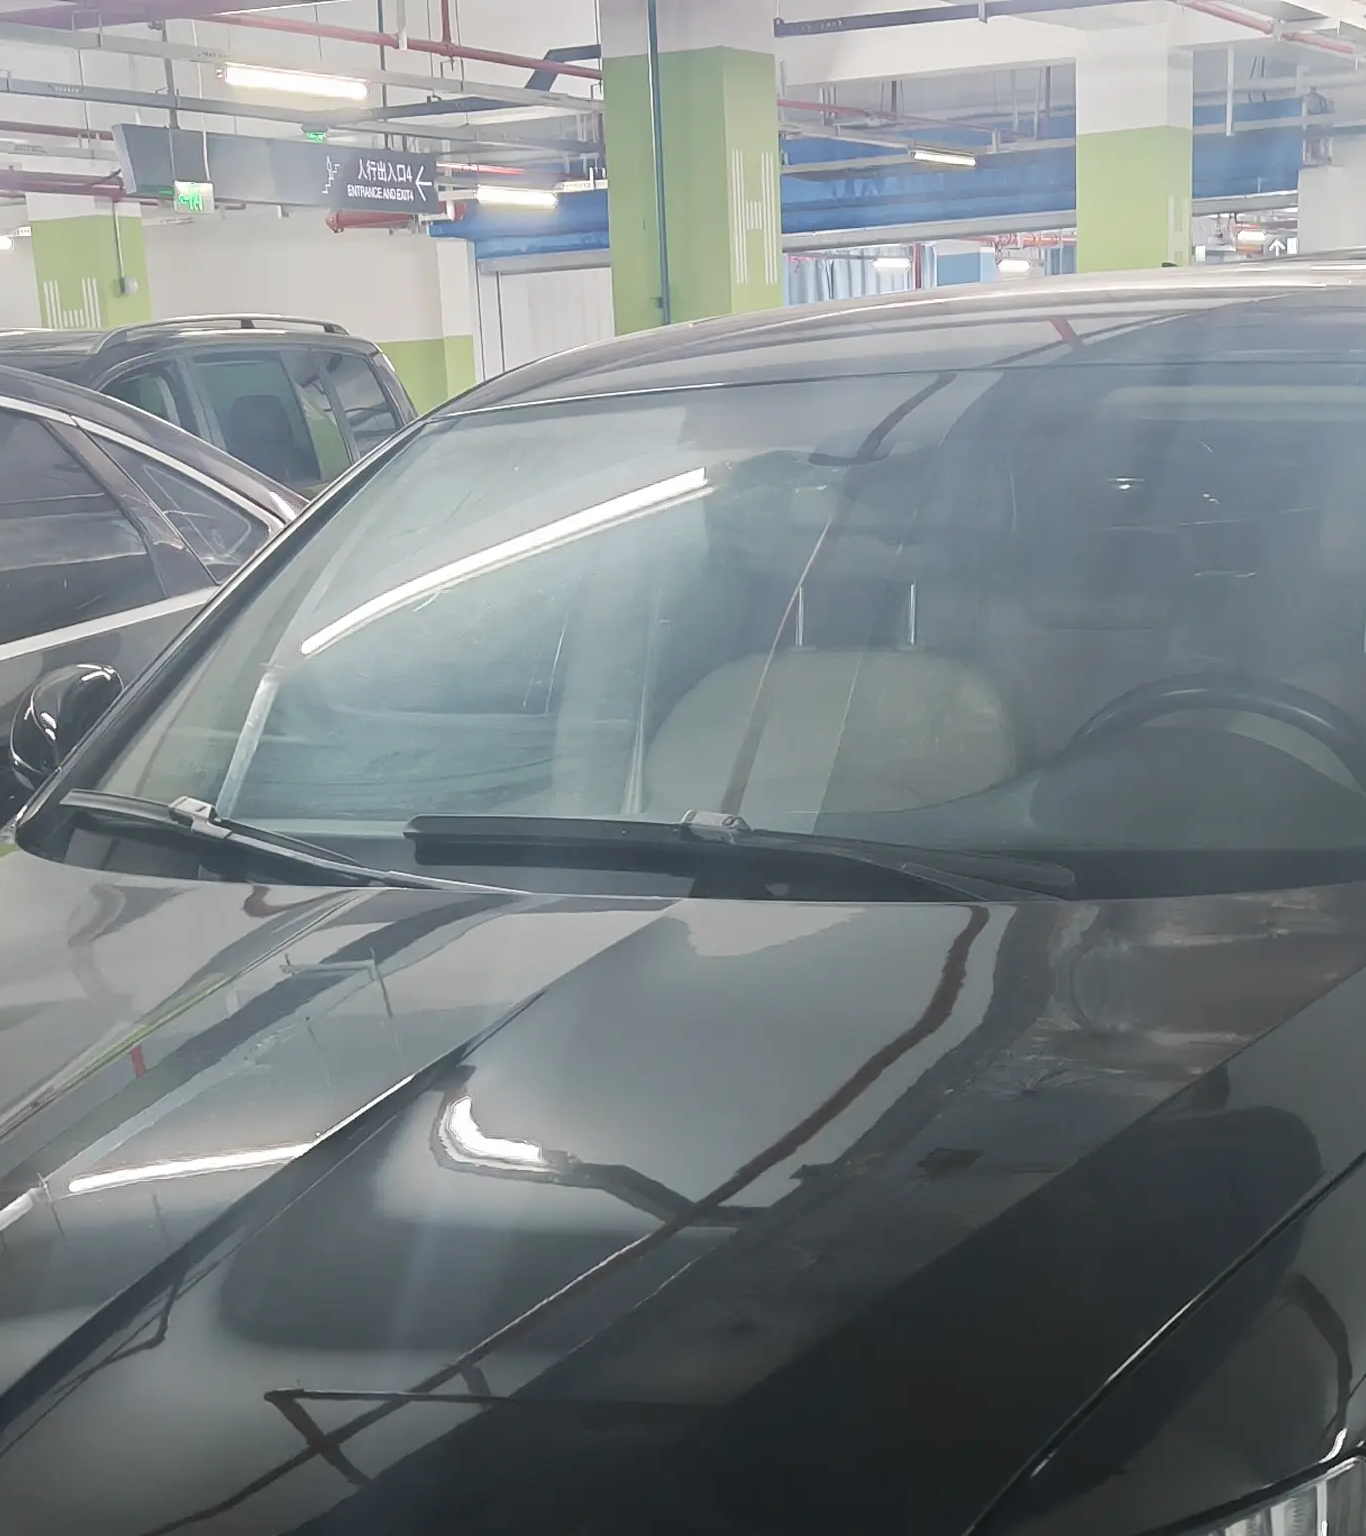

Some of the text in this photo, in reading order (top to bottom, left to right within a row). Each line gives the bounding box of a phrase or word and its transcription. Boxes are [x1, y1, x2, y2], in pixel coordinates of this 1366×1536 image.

[358, 158, 413, 184] 人行出入口4
[346, 184, 382, 199] ENTRANCE
[382, 187, 395, 200] AND
[731, 149, 778, 284] H
